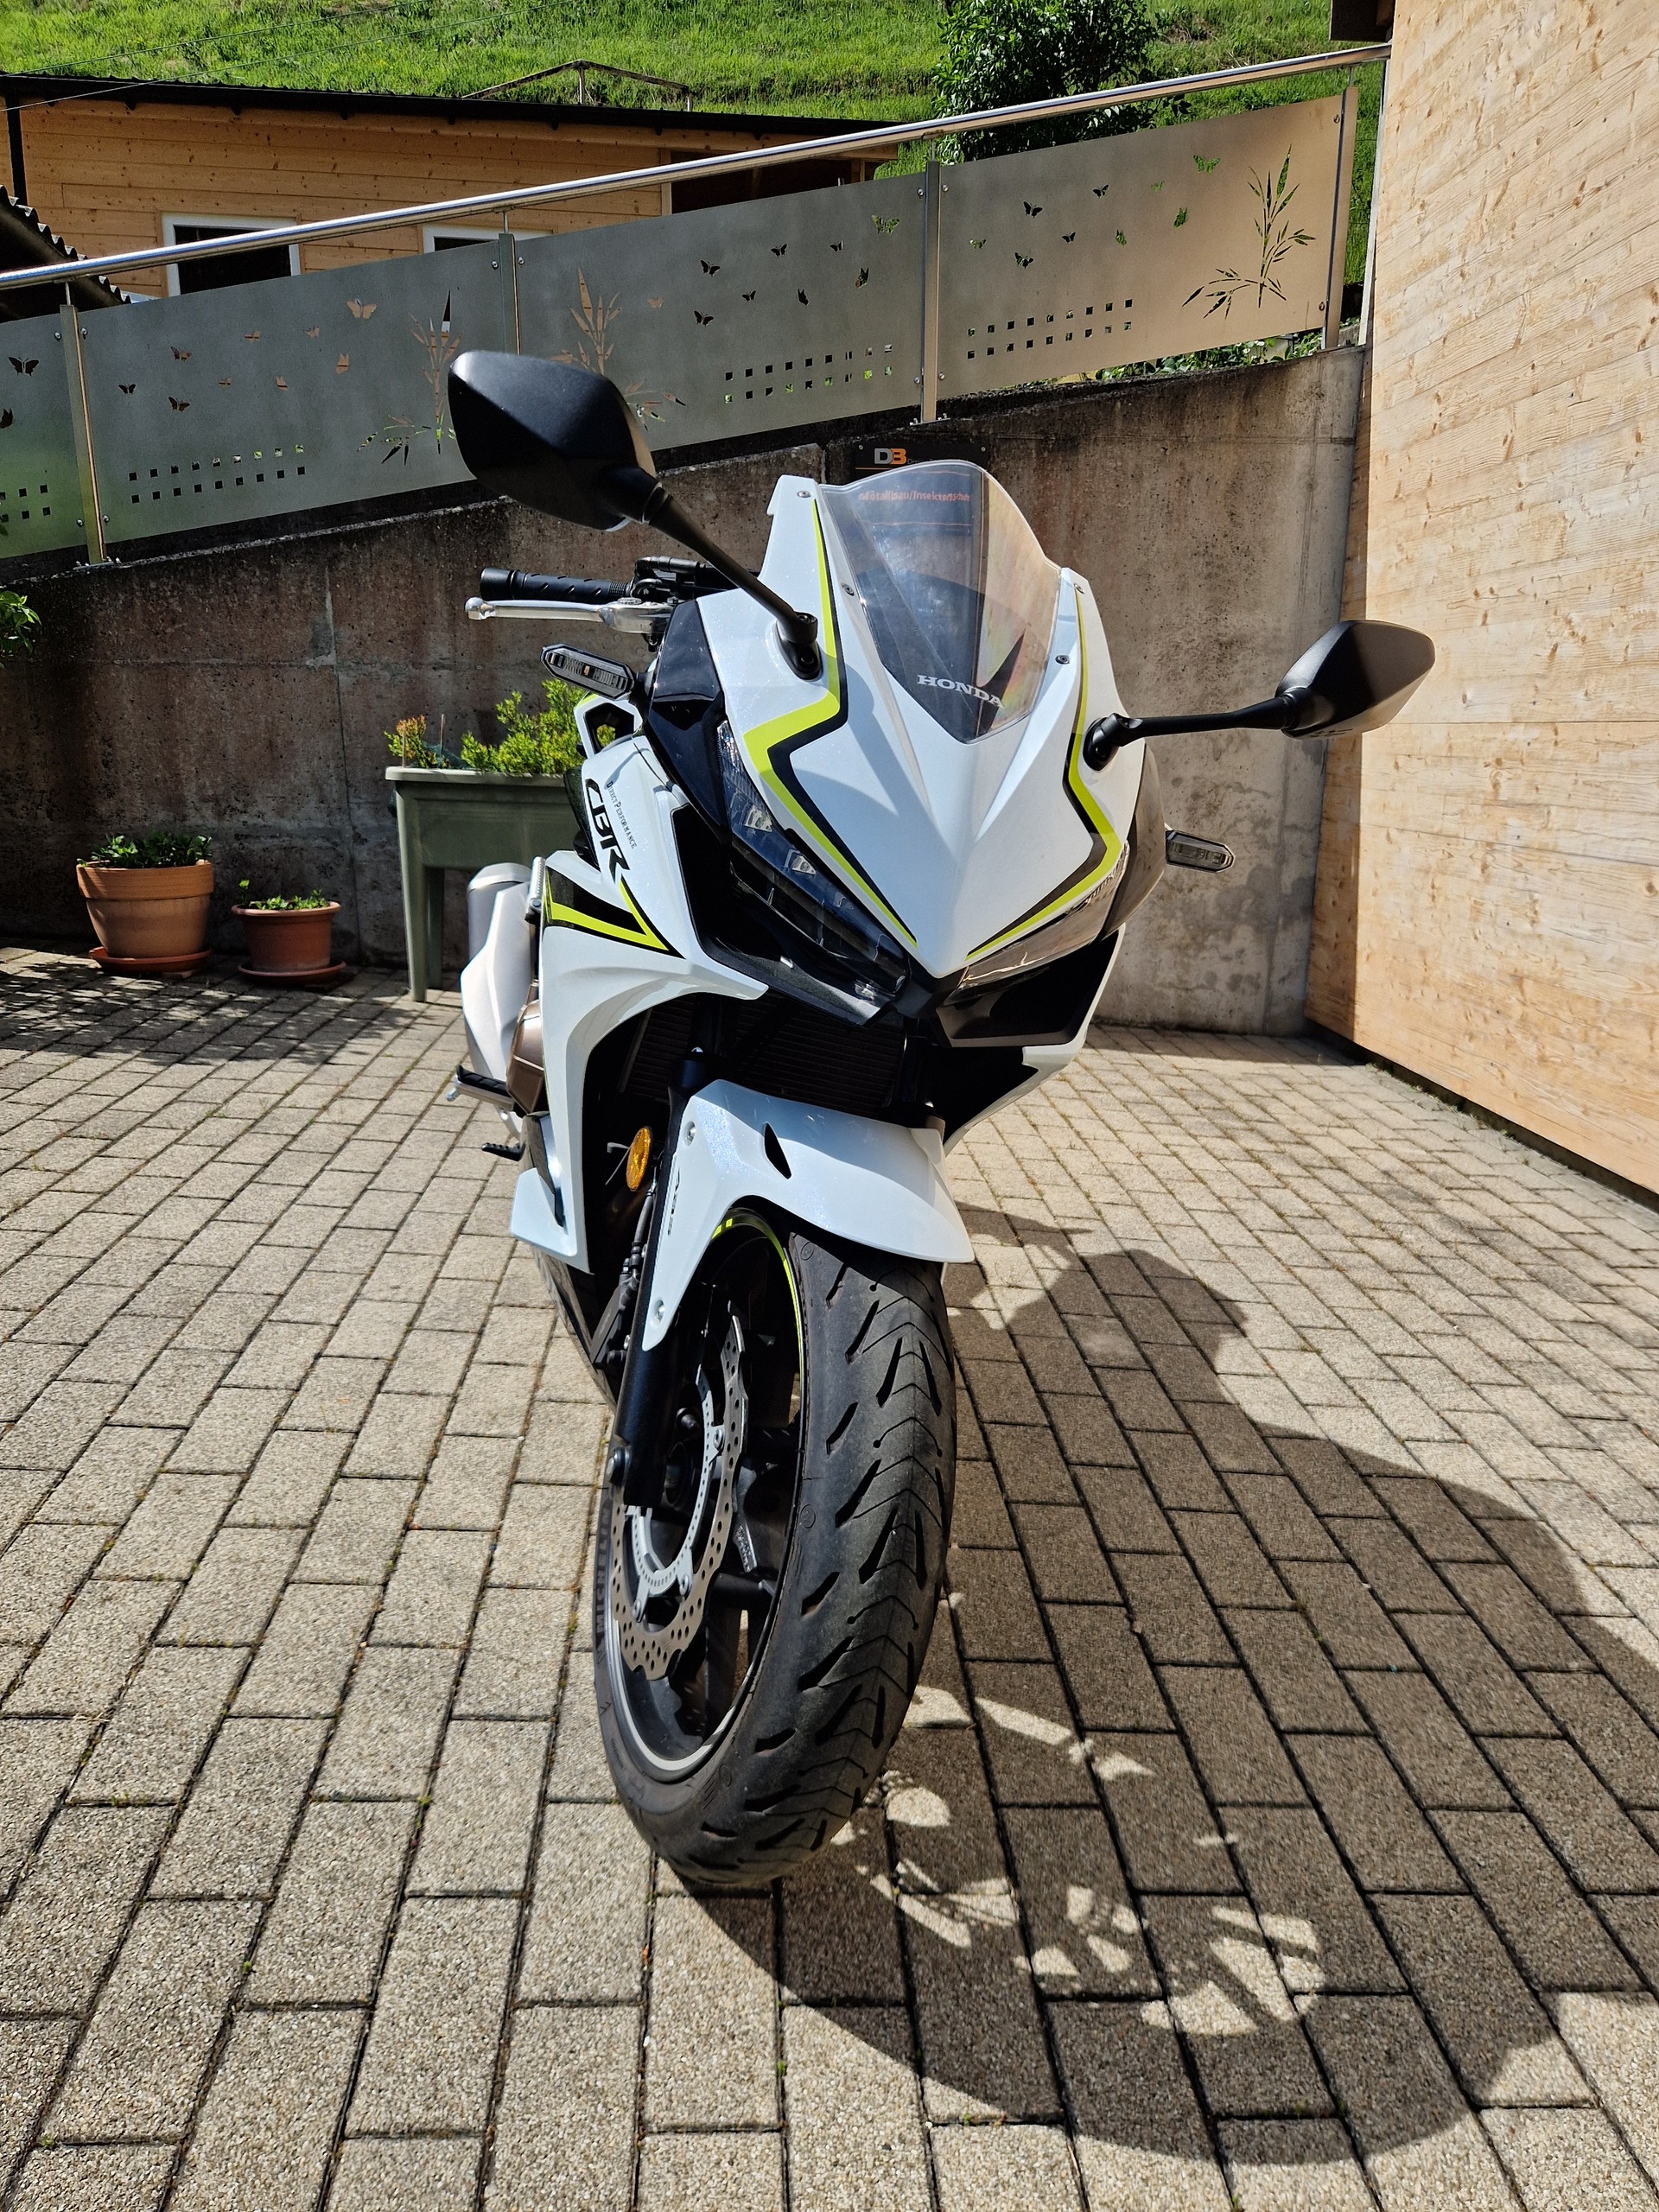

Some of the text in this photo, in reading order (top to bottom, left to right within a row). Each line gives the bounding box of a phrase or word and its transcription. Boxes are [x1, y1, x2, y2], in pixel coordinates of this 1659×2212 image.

[874, 448, 907, 465] DB
[917, 674, 1005, 709] HONDA
[585, 779, 630, 884] CBR
